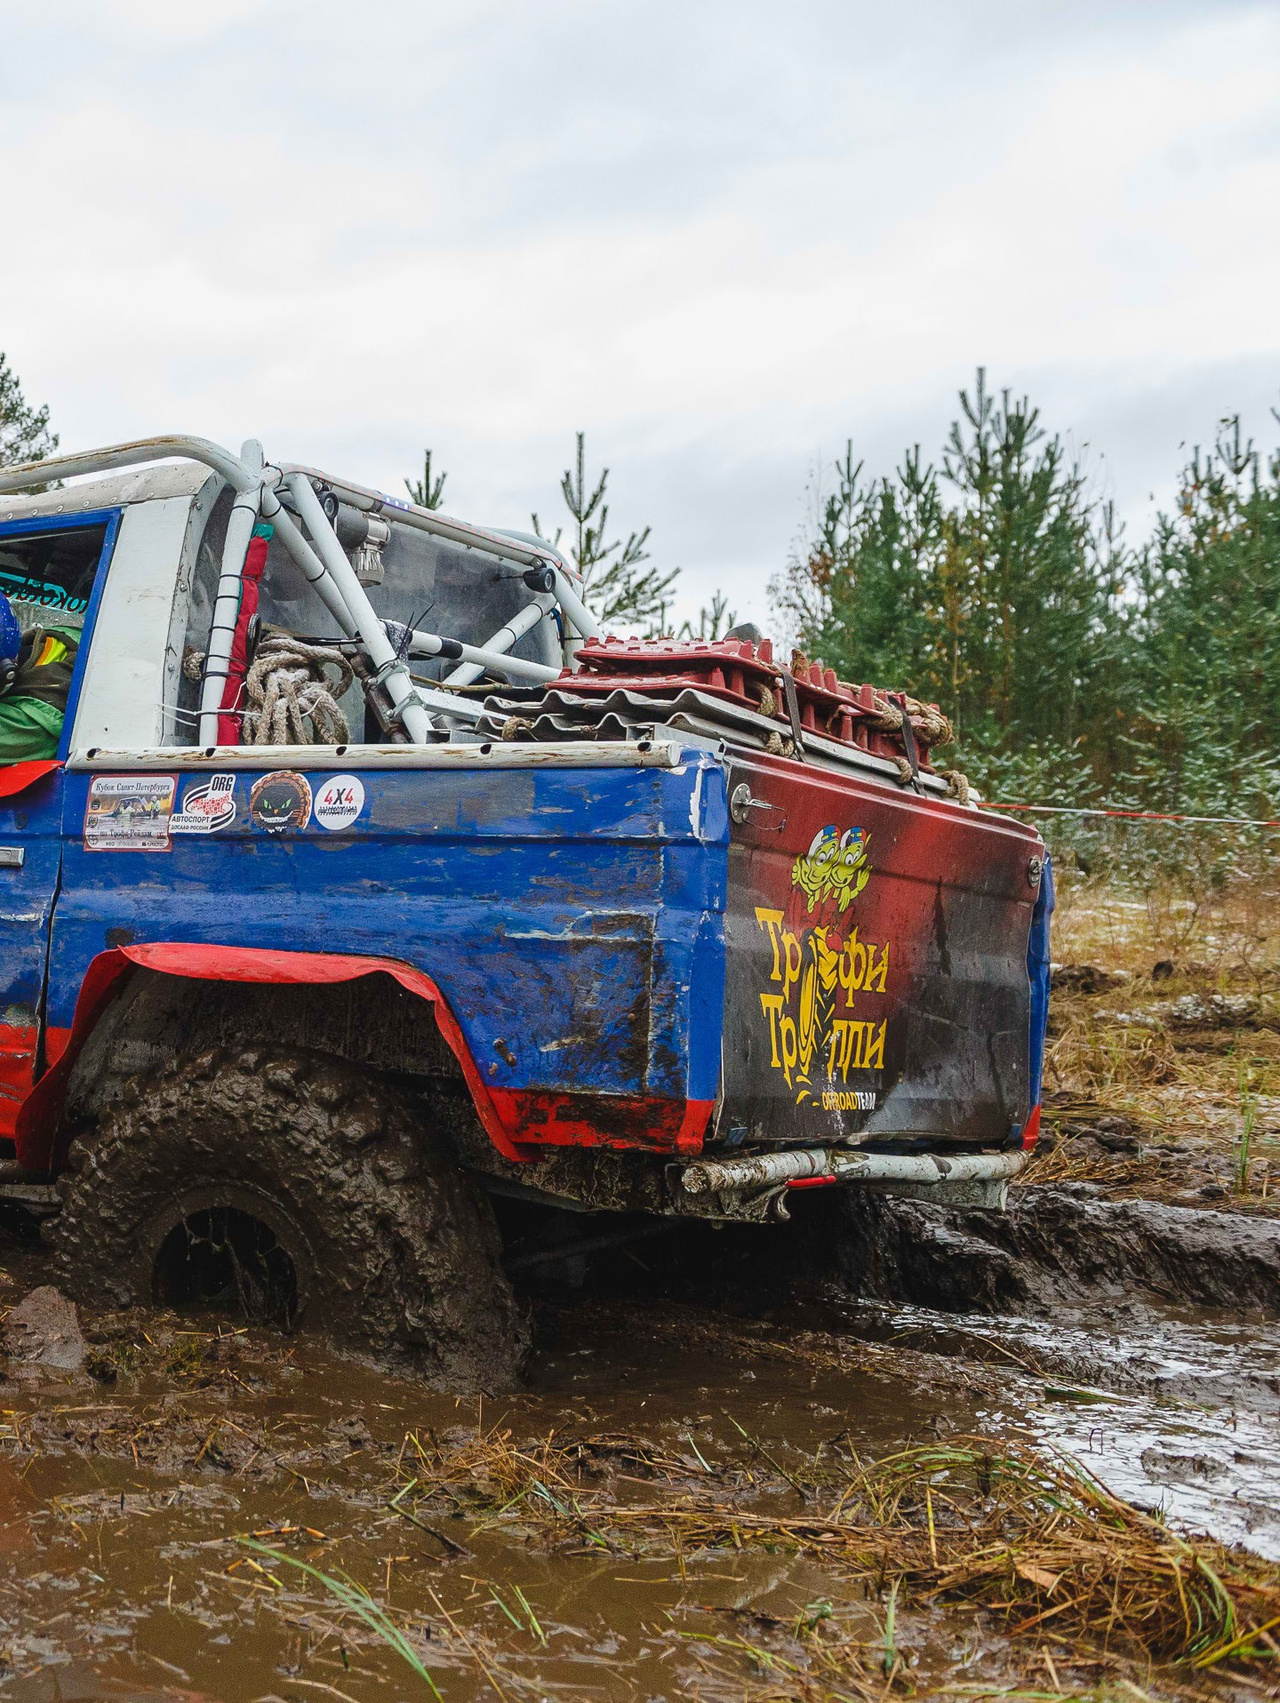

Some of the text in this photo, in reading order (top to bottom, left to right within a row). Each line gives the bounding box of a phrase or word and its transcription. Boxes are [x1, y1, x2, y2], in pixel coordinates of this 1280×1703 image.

[95, 782, 170, 793] Кубок Санкт-Петербурга
[211, 776, 234, 791] ORG
[171, 815, 210, 823] АВТОСПОРТ
